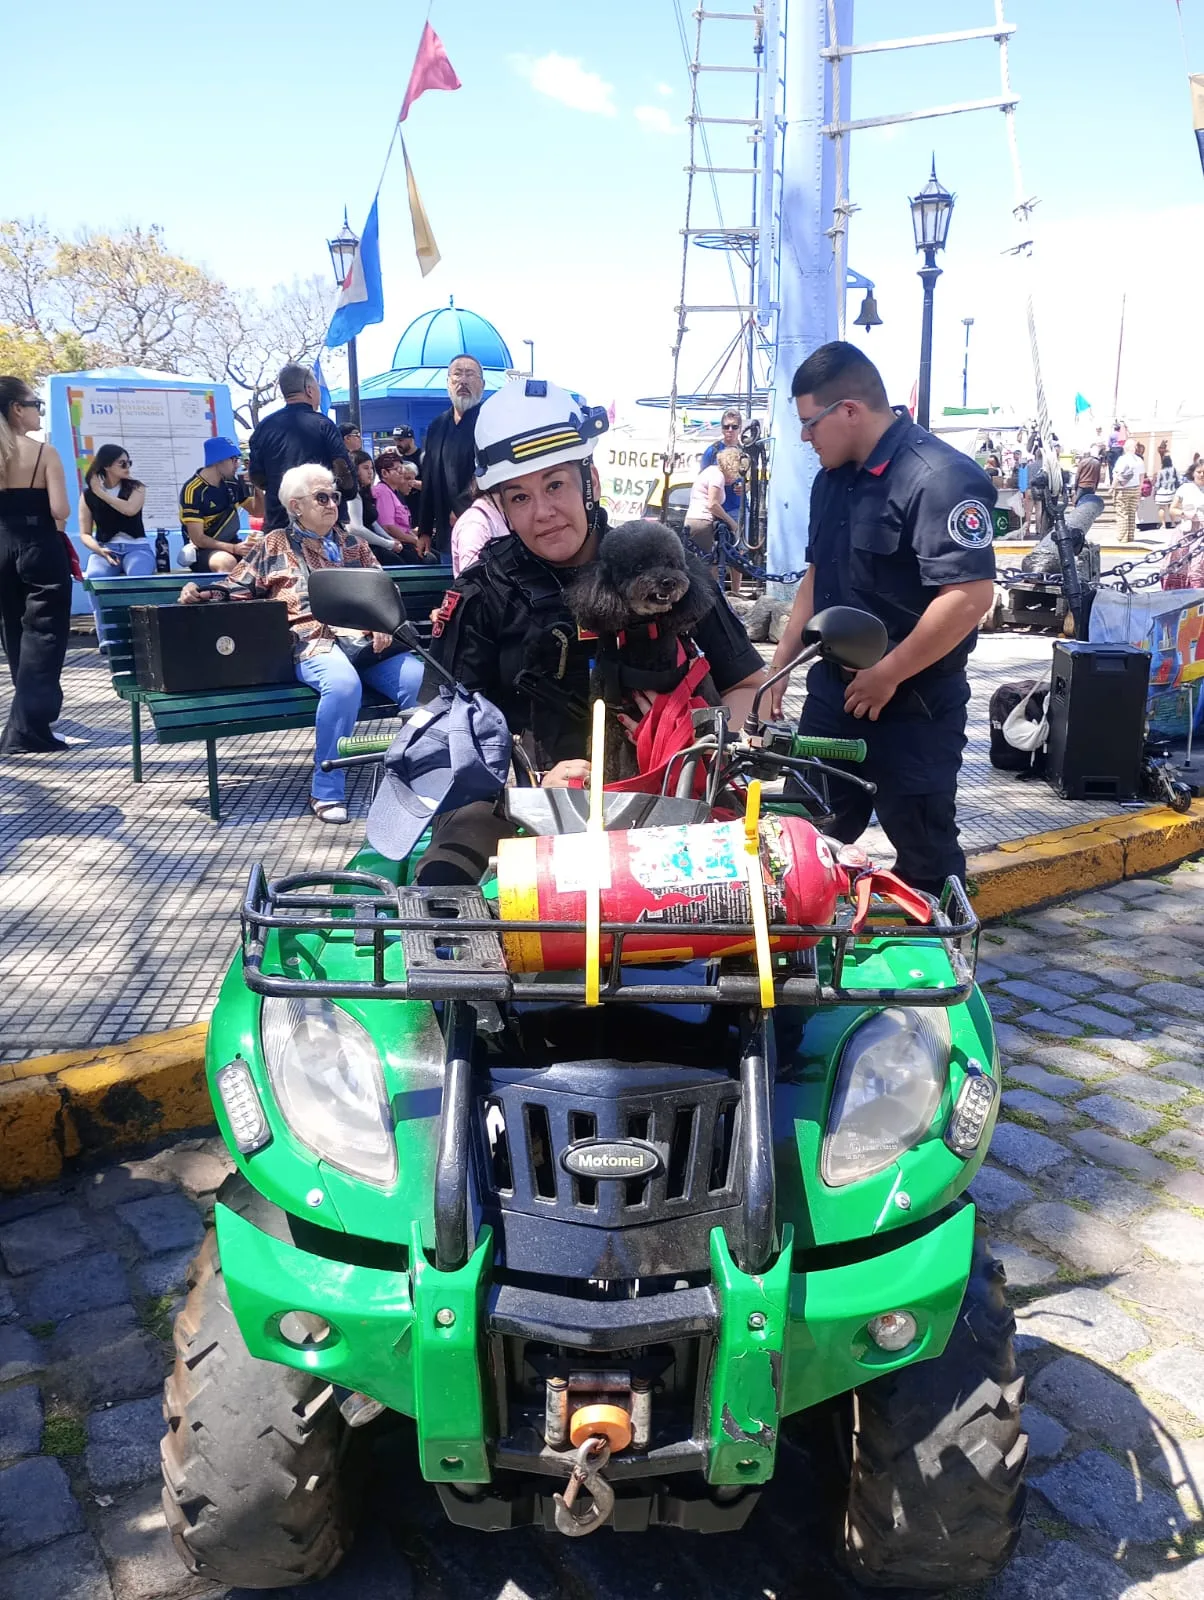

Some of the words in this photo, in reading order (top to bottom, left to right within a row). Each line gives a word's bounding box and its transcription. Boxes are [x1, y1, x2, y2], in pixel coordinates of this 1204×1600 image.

[90, 404, 113, 415] 150
[609, 450, 659, 468] JORGE
[578, 1154, 644, 1167] Motomel
